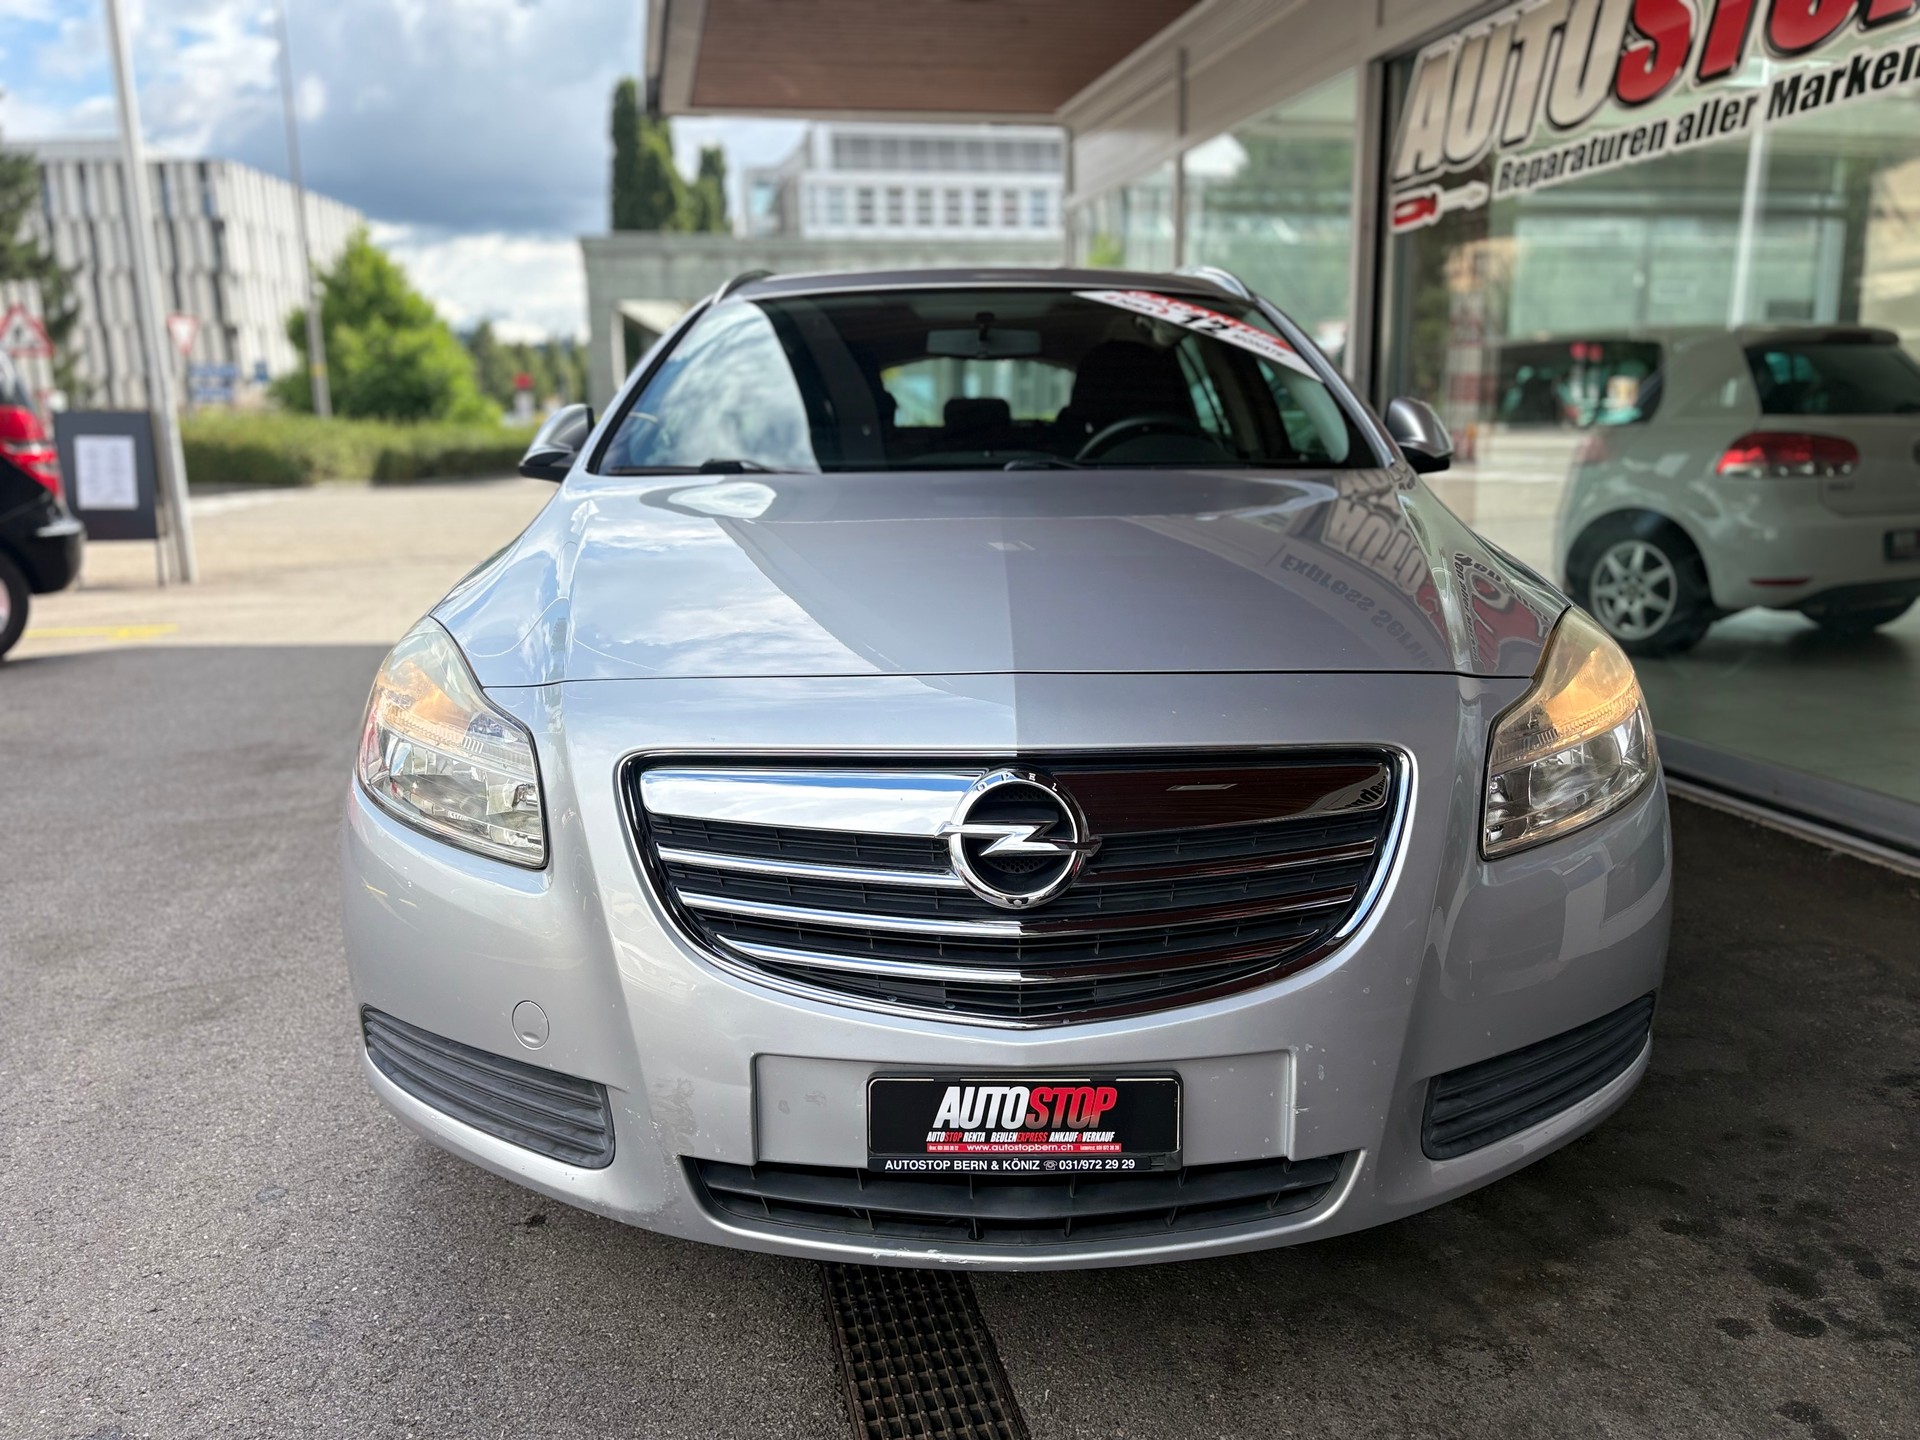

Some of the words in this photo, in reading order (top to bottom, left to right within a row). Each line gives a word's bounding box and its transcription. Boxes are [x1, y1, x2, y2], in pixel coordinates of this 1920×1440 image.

[1391, 0, 1918, 184] AUTOS
[1500, 118, 1669, 191] Reparaturen
[1674, 92, 1760, 152] aller
[976, 772, 1058, 793] OPEL
[932, 1086, 1118, 1130] AUTOSTOP
[926, 1131, 963, 1142] AUTOSTOP
[963, 1131, 986, 1142] RENTA
[967, 1144, 1074, 1152] www.autostopbern.ch
[885, 1160, 951, 1171] AUTOSTOP
[953, 1160, 988, 1170] BERN
[991, 1160, 999, 1170] &
[1002, 1158, 1040, 1170] KÖNIZ
[1059, 1159, 1103, 1170] 031/972
[1105, 1159, 1119, 1169] 29
[1121, 1159, 1136, 1169] 29
